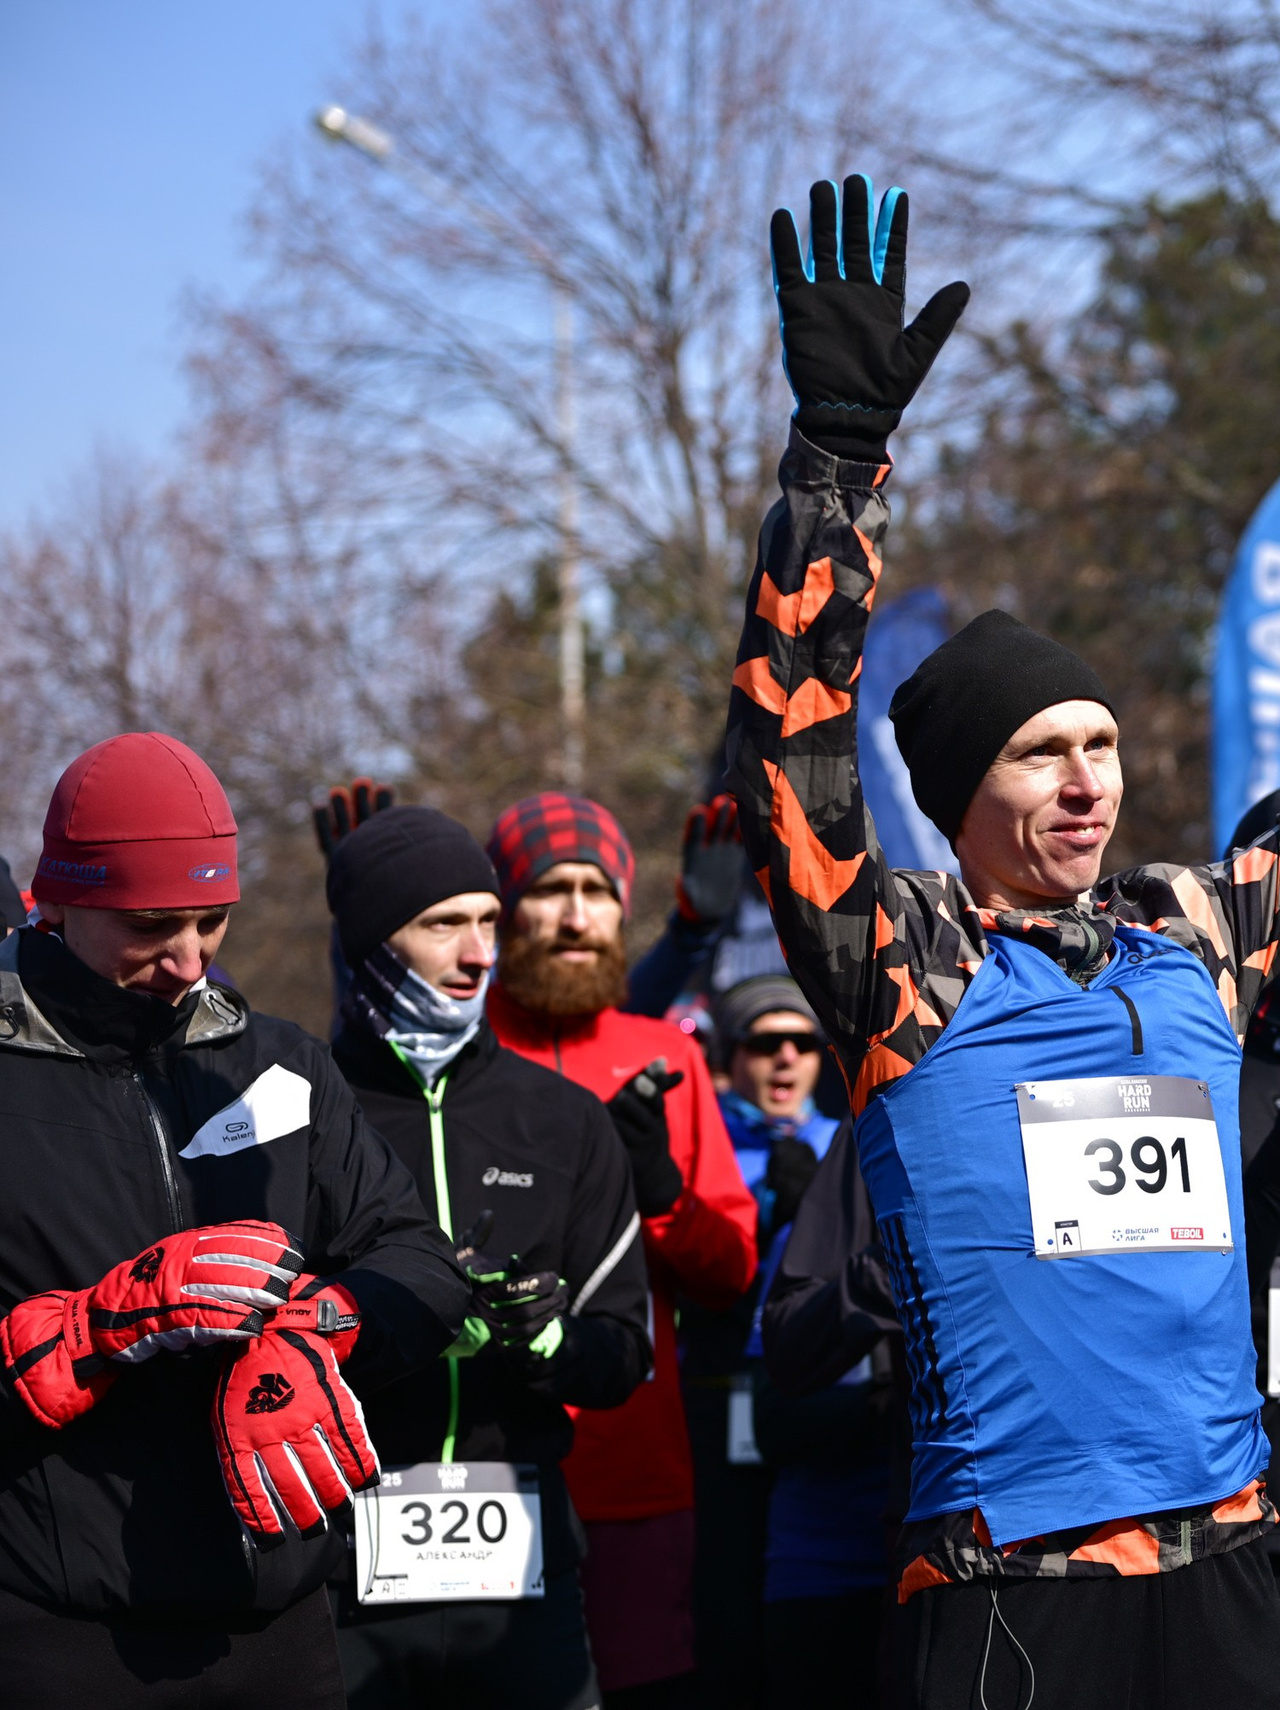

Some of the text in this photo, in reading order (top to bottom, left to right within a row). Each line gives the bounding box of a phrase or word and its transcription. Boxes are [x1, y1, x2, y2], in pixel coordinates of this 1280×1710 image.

[1117, 1084, 1152, 1097] HARD
[1123, 1096, 1151, 1109] RUN
[222, 1130, 256, 1143] Kalenj
[1084, 1136, 1191, 1195] 391
[498, 1171, 535, 1188] asics
[1172, 1228, 1202, 1239] TEBOIL
[285, 1308, 311, 1316] AQUA
[382, 1472, 402, 1487] 25
[401, 1500, 508, 1545] 320
[416, 1549, 493, 1561] АЛЕКСАНДР
